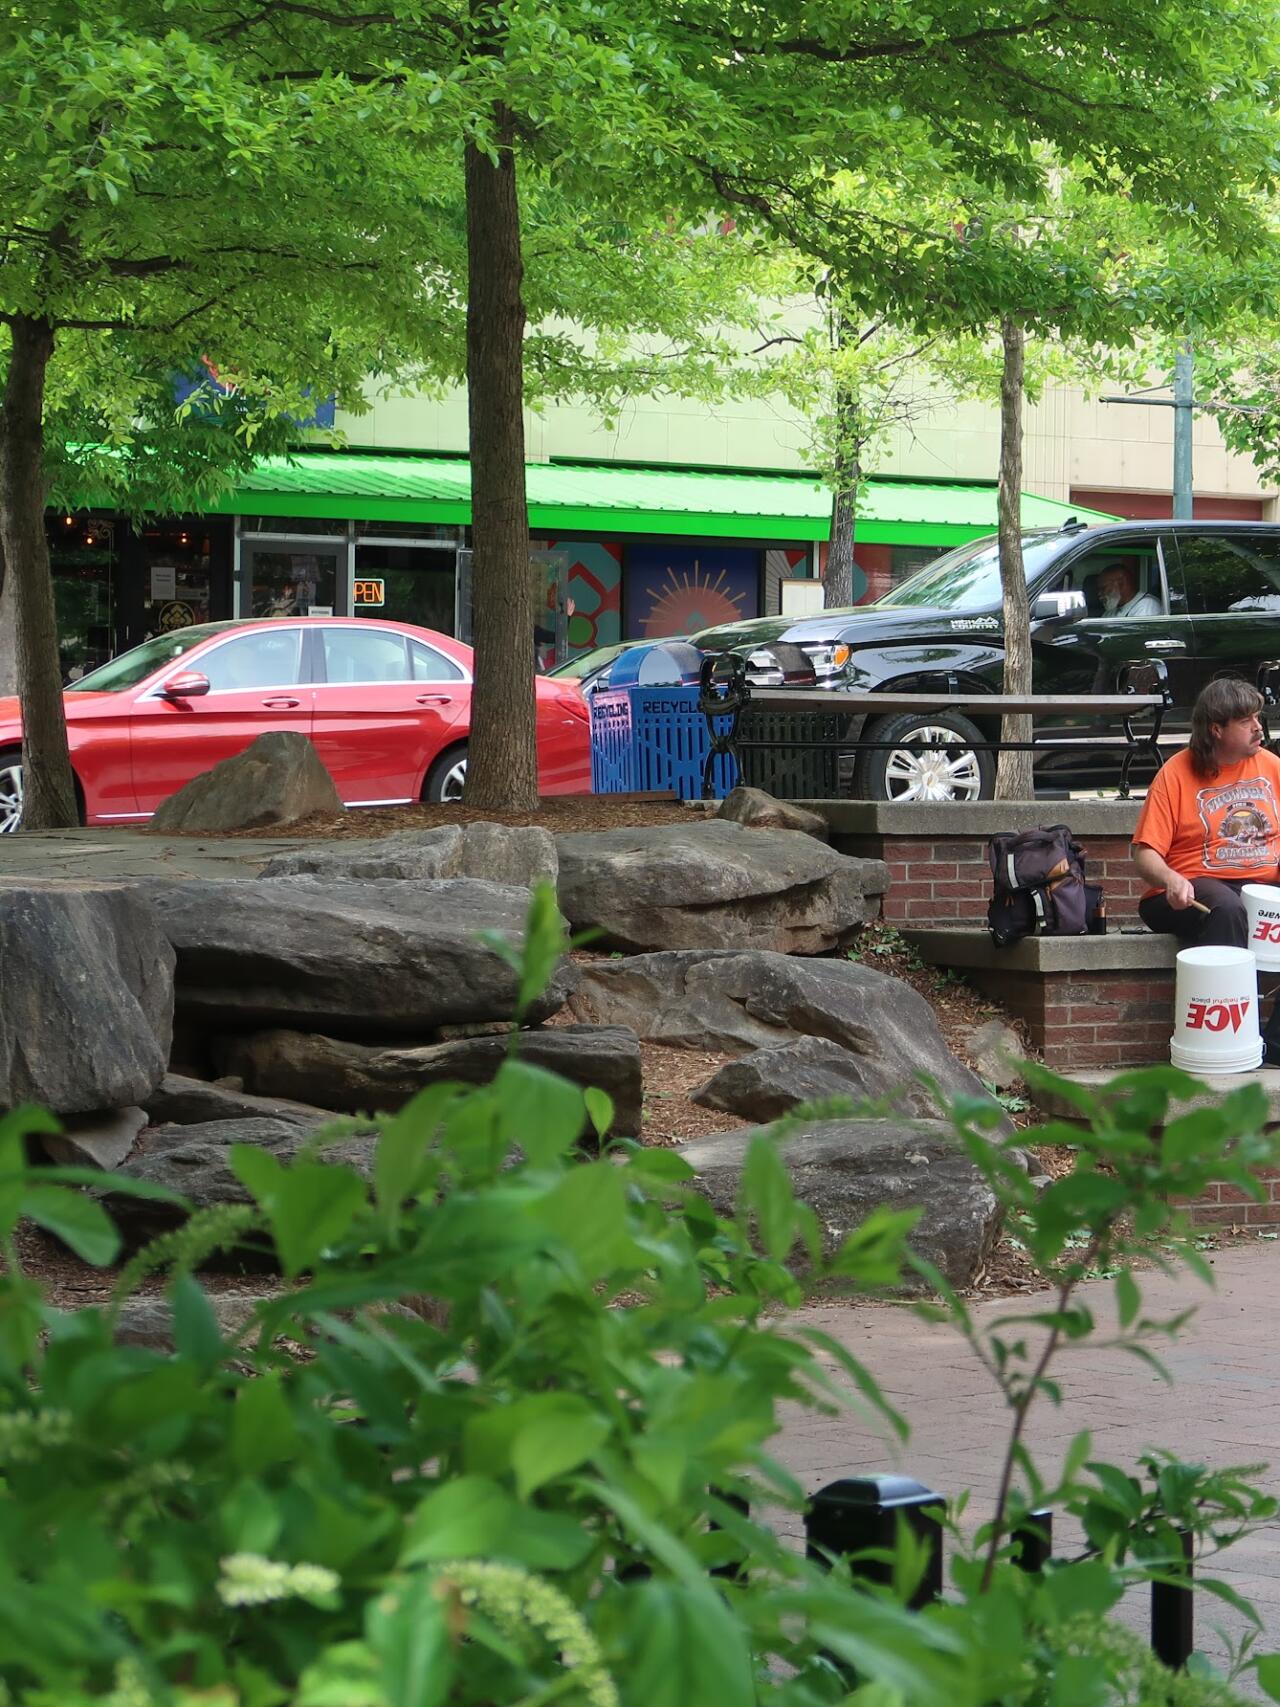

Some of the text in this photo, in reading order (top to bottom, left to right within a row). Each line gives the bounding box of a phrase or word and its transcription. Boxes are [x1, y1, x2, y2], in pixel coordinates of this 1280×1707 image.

[353, 582, 383, 602] PEN
[592, 702, 629, 719] RECYCLING
[642, 701, 700, 714] RECYCL
[1213, 996, 1238, 1004] helpful
[1185, 1001, 1250, 1035] ACE
